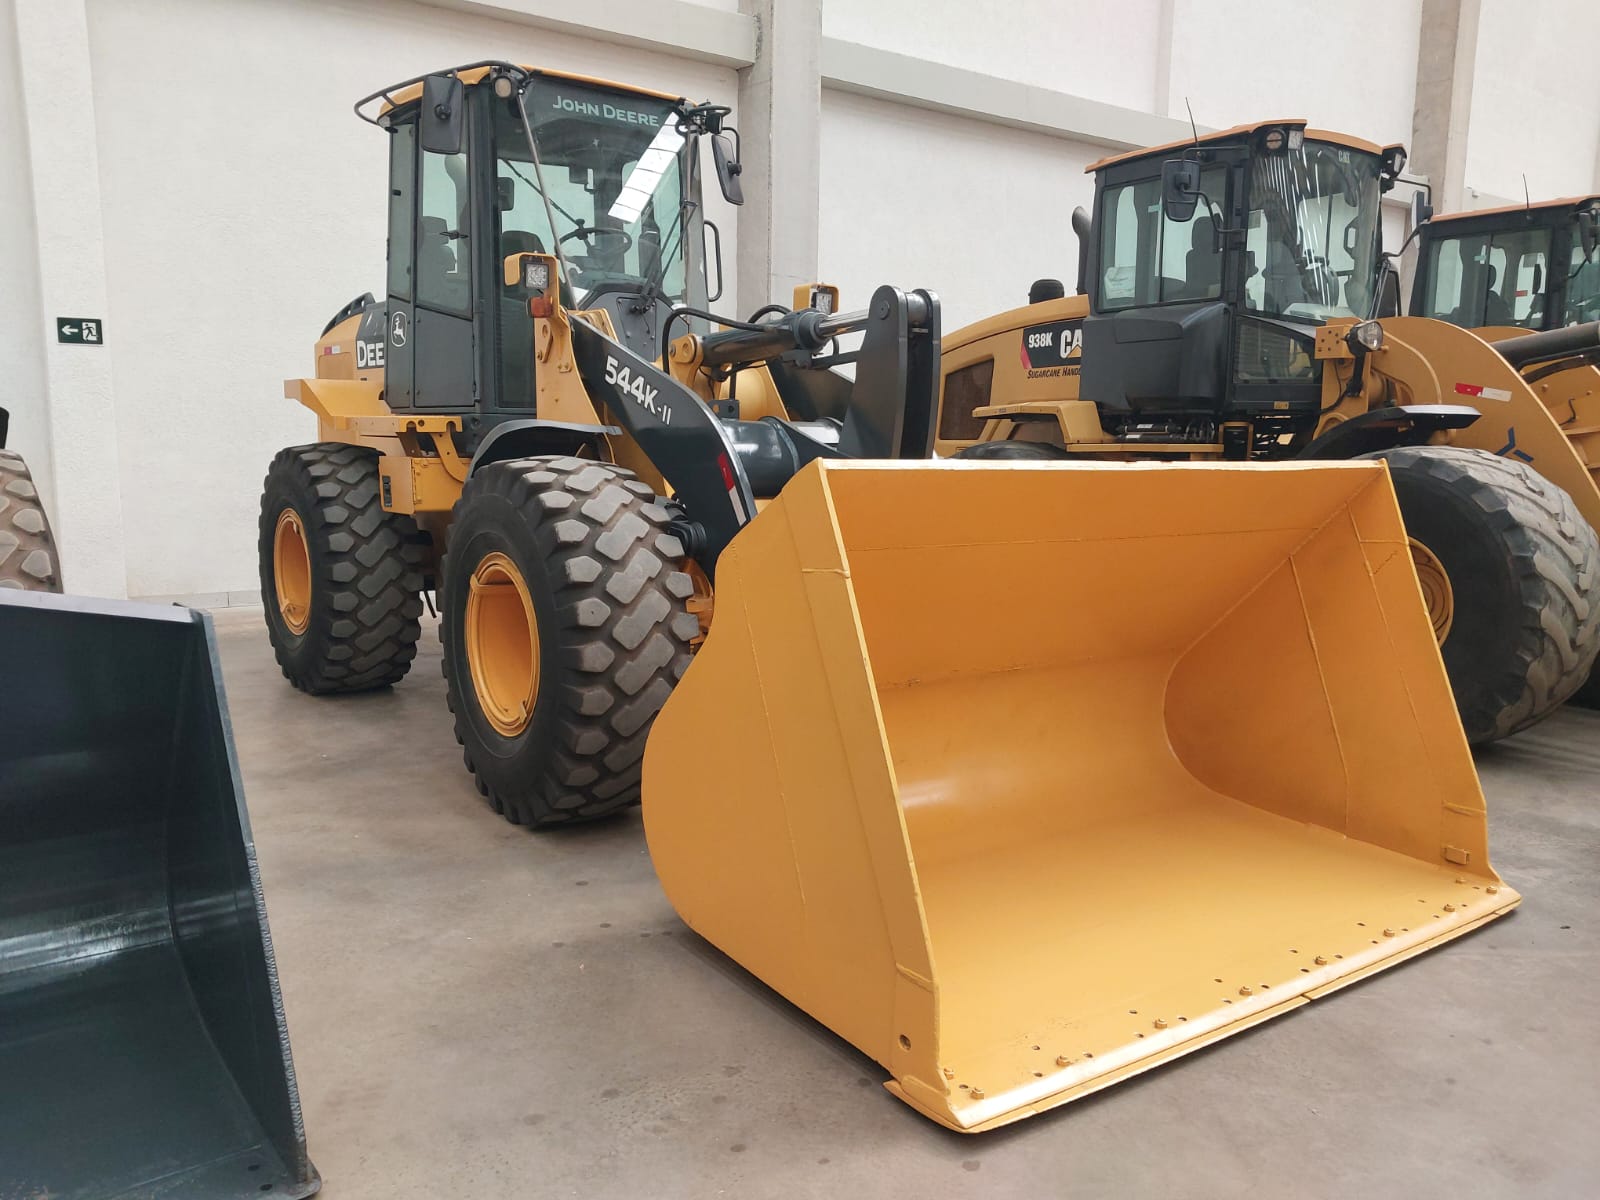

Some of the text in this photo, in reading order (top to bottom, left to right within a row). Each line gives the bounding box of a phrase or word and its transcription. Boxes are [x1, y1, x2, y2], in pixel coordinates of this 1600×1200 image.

[552, 96, 660, 127] JOHN DEERE
[1028, 332, 1053, 348] 938K
[356, 340, 385, 368] DEE
[1027, 369, 1061, 379] SUGARCANE
